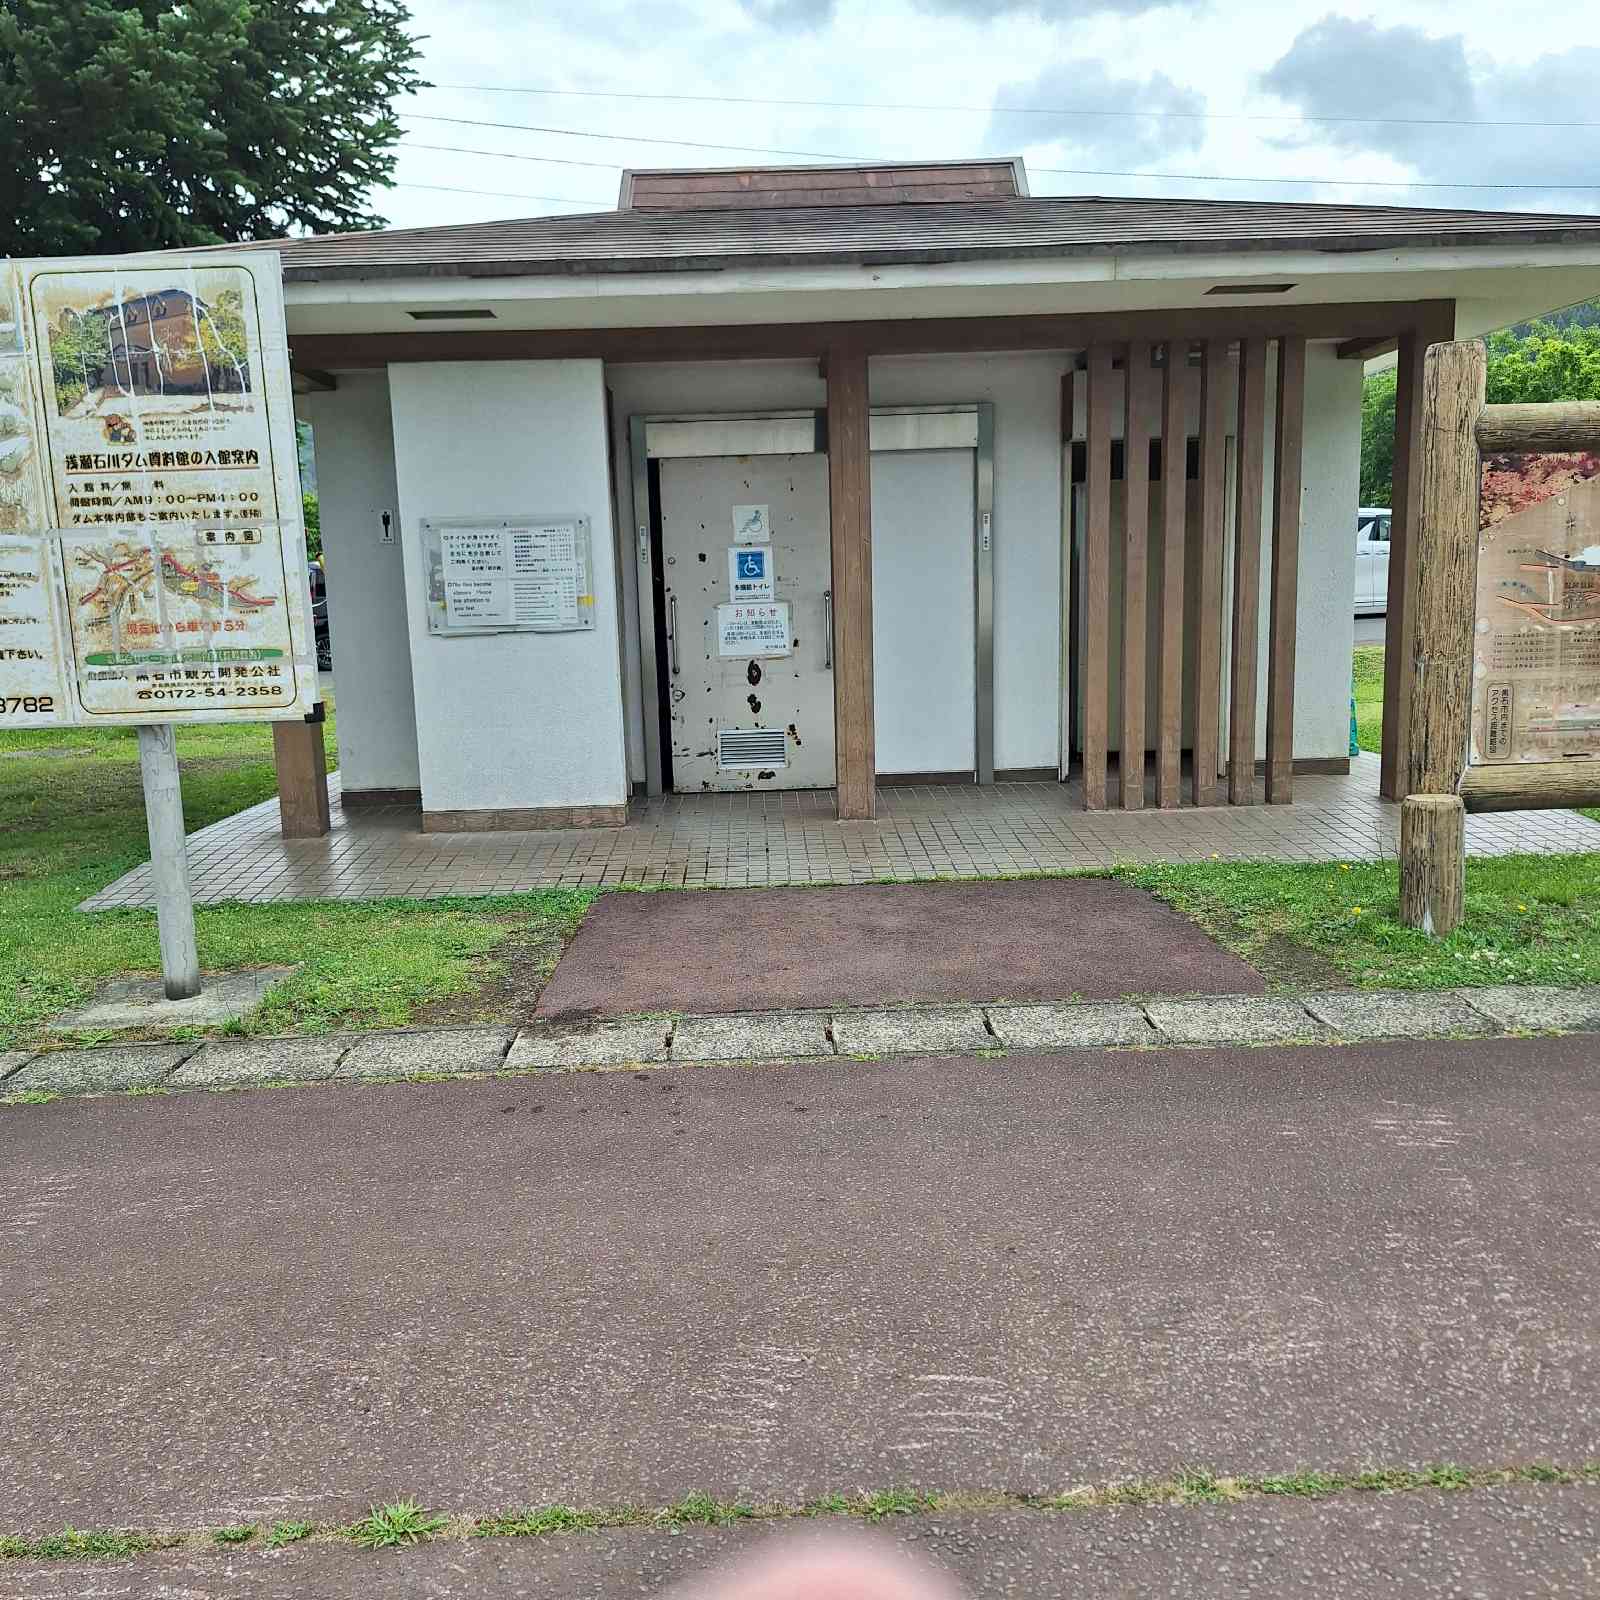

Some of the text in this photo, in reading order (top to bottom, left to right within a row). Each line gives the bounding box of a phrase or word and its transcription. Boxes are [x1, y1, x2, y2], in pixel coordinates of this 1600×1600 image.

[65, 449, 259, 469] 浅瀬石川ダム資料館の入館案内
[735, 607, 777, 618] お知らせ
[154, 686, 282, 699] 0172-54-2358
